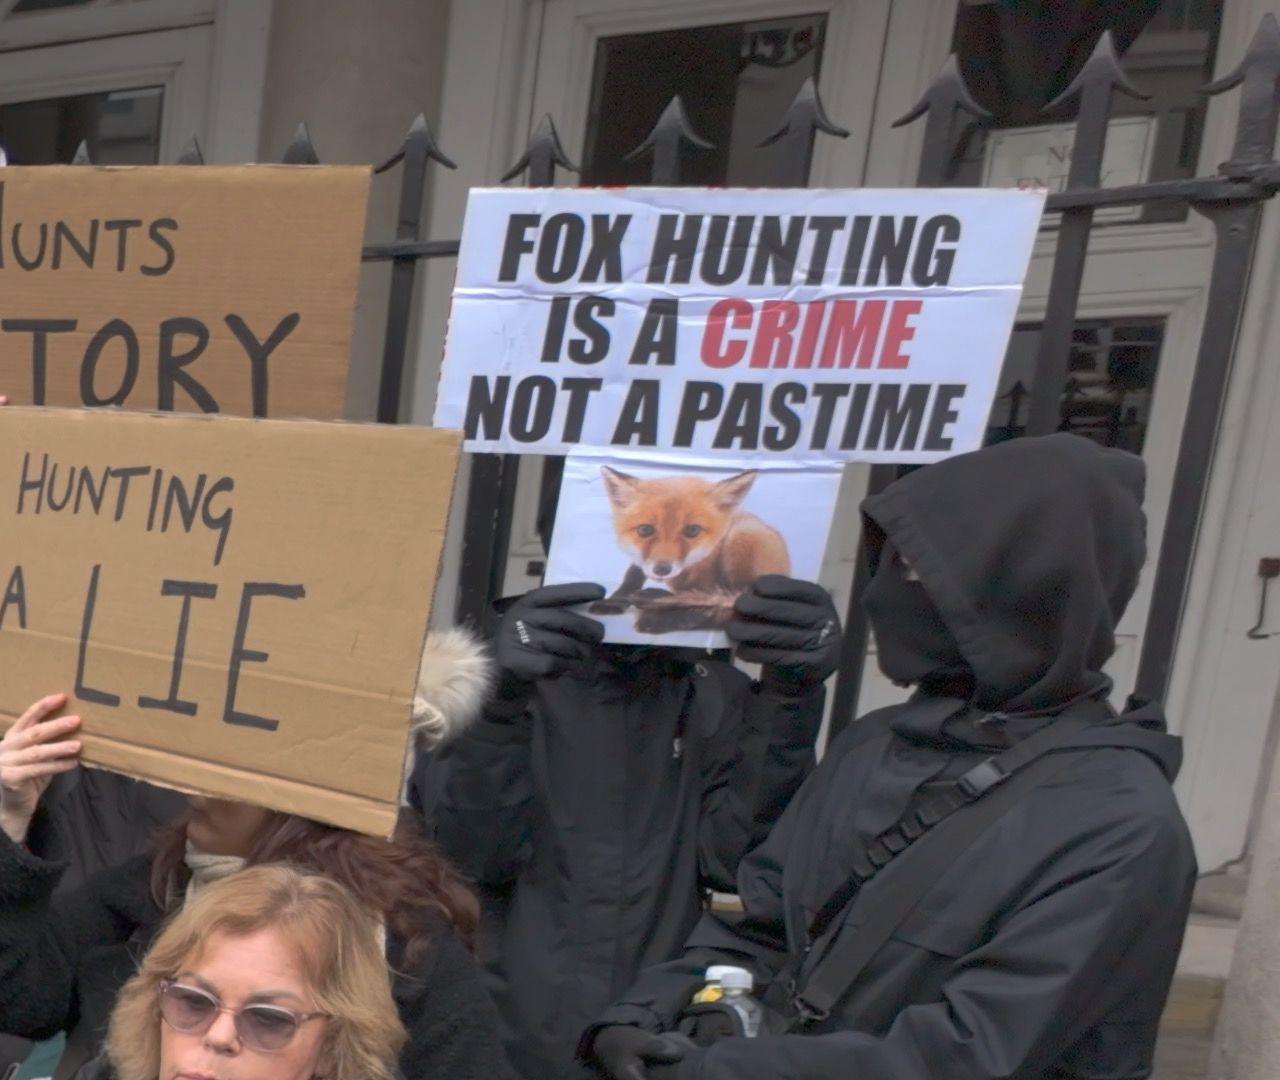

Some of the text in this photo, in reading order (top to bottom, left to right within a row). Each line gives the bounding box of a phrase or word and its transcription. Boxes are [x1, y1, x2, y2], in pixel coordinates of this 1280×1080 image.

[498, 213, 962, 287] FOX HUNTING
[540, 296, 924, 370] IS A CRIME
[464, 375, 967, 451] NOT A PASTIME
[16, 452, 235, 566] HUNTING
[73, 564, 307, 731] LIE
